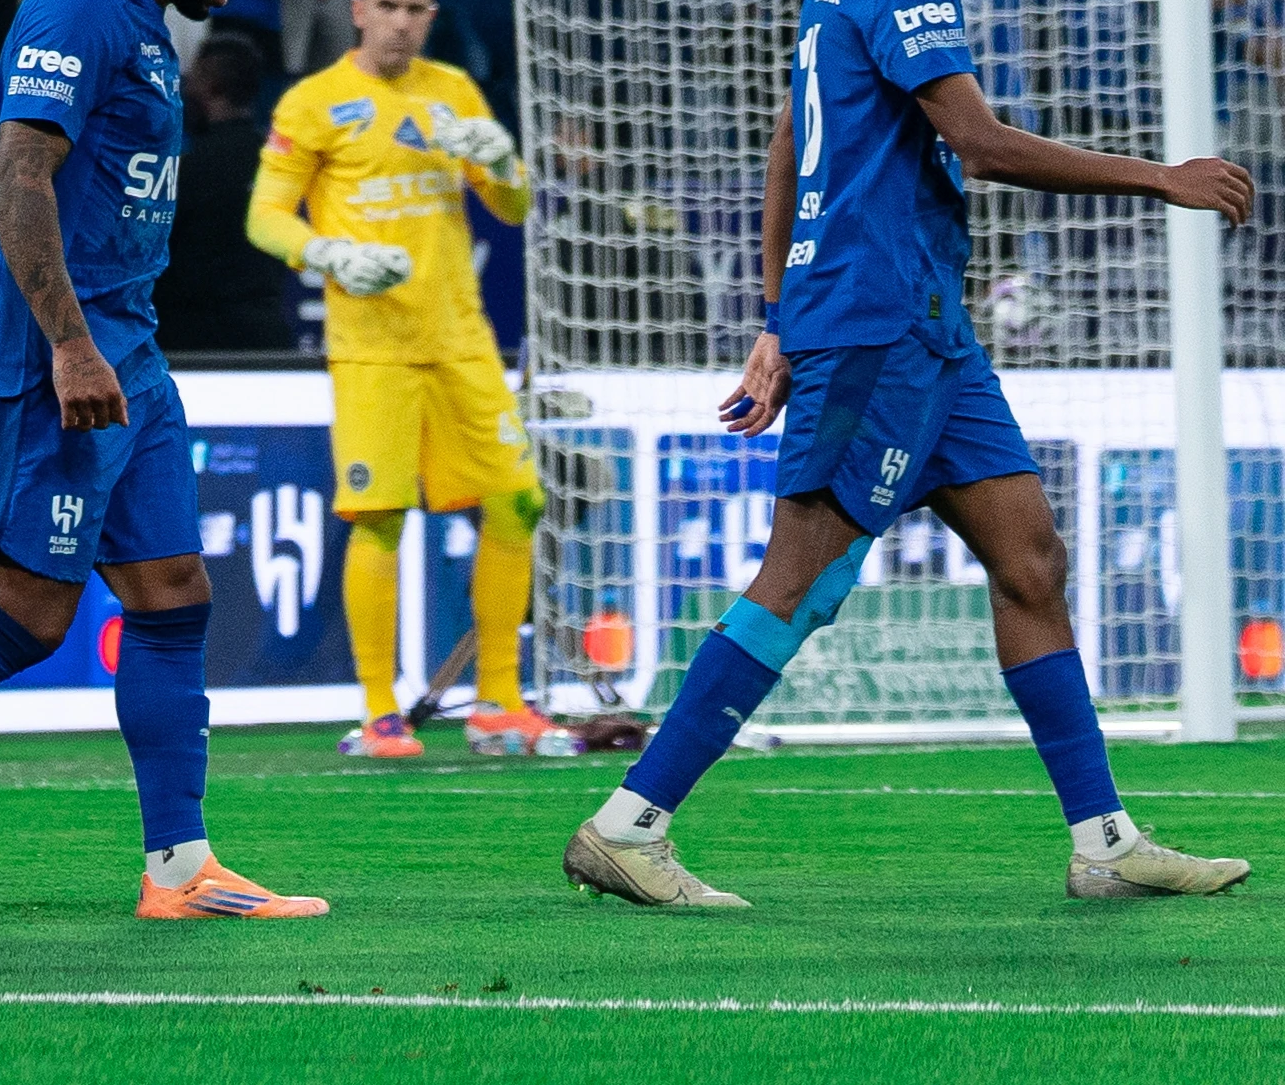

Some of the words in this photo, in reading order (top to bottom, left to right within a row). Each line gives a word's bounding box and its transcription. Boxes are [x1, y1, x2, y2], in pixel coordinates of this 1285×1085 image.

[893, 2, 958, 33] tree
[915, 28, 966, 45] SANABIL
[17, 45, 83, 78] tree
[18, 76, 76, 99] SANABIL
[121, 205, 174, 224] GAMES
